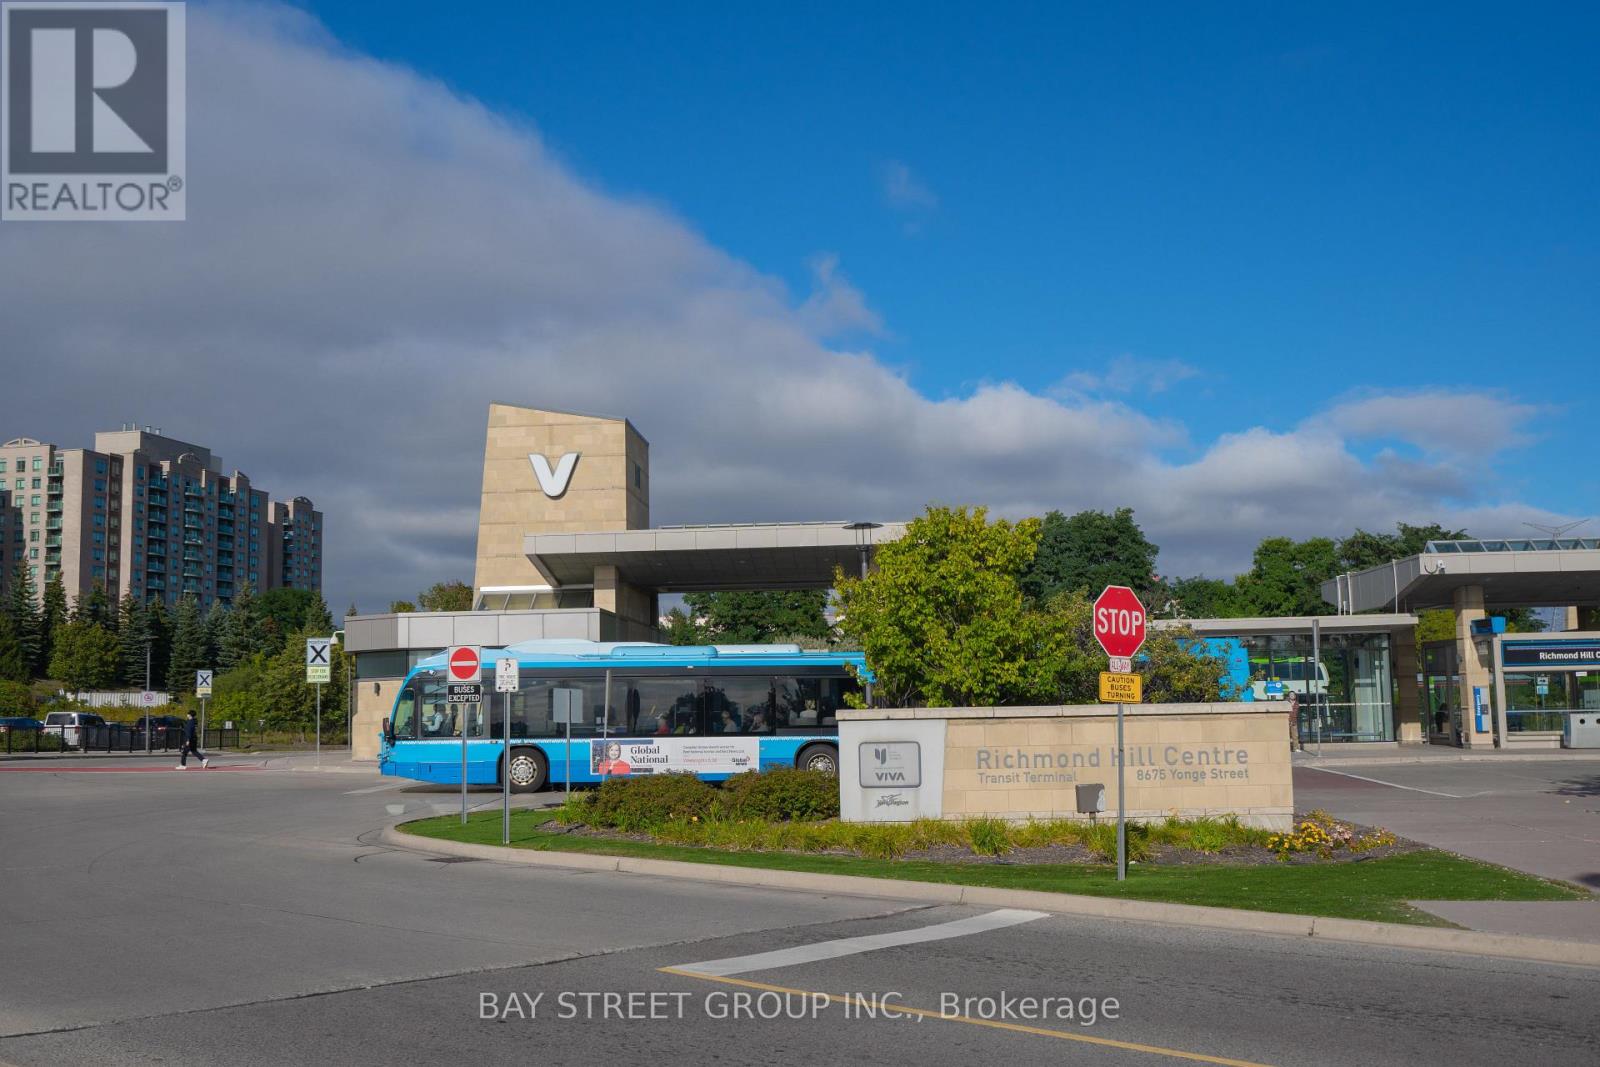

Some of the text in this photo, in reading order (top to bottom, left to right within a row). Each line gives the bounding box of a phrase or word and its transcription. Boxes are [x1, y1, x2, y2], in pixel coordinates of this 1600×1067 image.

[1097, 607, 1142, 636] STOP
[1539, 651, 1578, 660] Richmond
[1580, 651, 1594, 659] Hill
[1107, 676, 1135, 685] CAUTION
[1110, 684, 1132, 692] BUSES
[448, 694, 480, 702] EXCEPTED
[1106, 691, 1136, 700] TURNING
[630, 745, 660, 755] Global
[630, 755, 669, 764] National
[976, 748, 1100, 769] Richmond
[1163, 746, 1249, 766] Centre
[875, 772, 905, 781] VIVA
[977, 770, 1078, 784] Transit Terminal
[1136, 768, 1249, 782] 8675 Yonge Street
